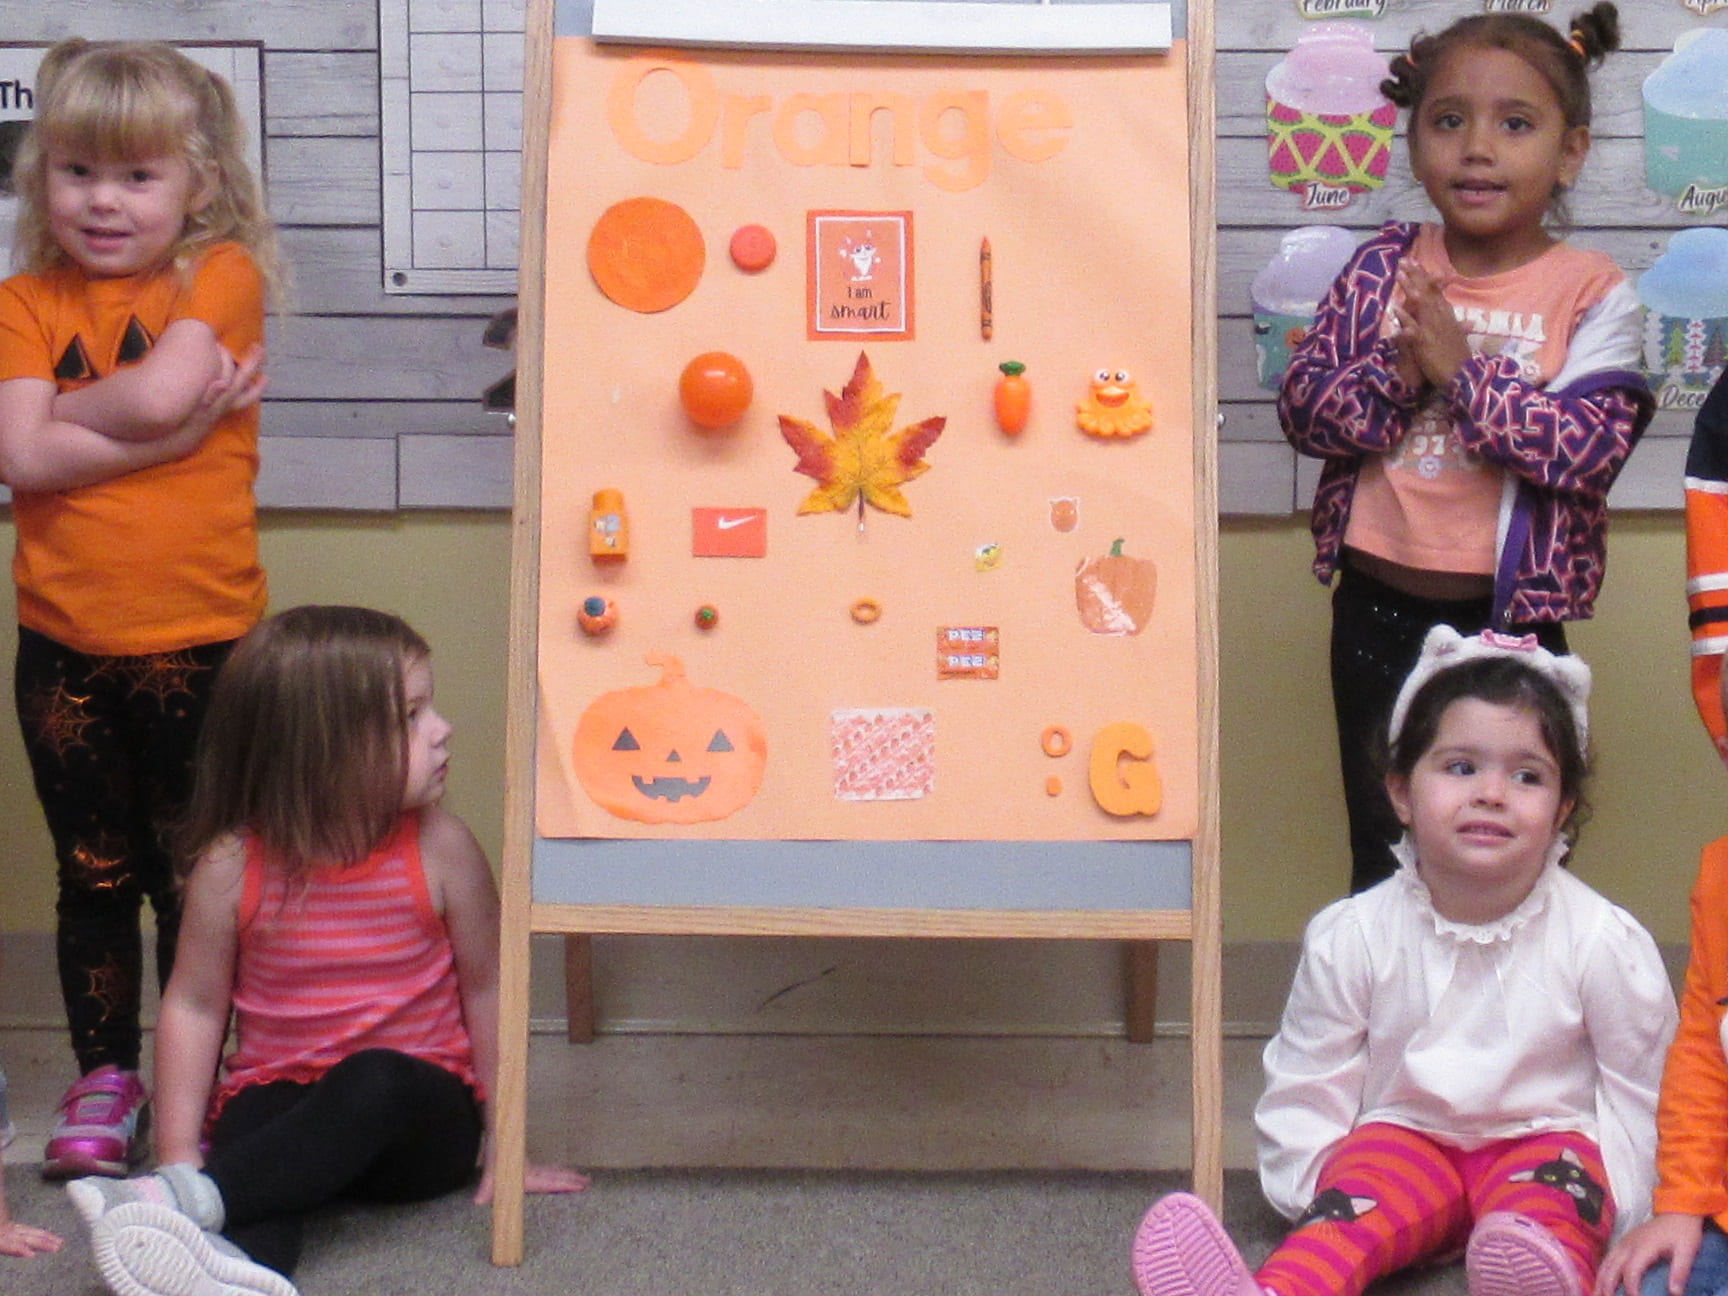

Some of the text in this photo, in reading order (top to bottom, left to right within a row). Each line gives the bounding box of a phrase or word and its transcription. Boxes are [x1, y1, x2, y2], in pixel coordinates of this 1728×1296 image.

[608, 51, 1074, 193] Orange
[1305, 183, 1351, 207] June
[856, 286, 873, 299] am
[829, 300, 892, 321] smart
